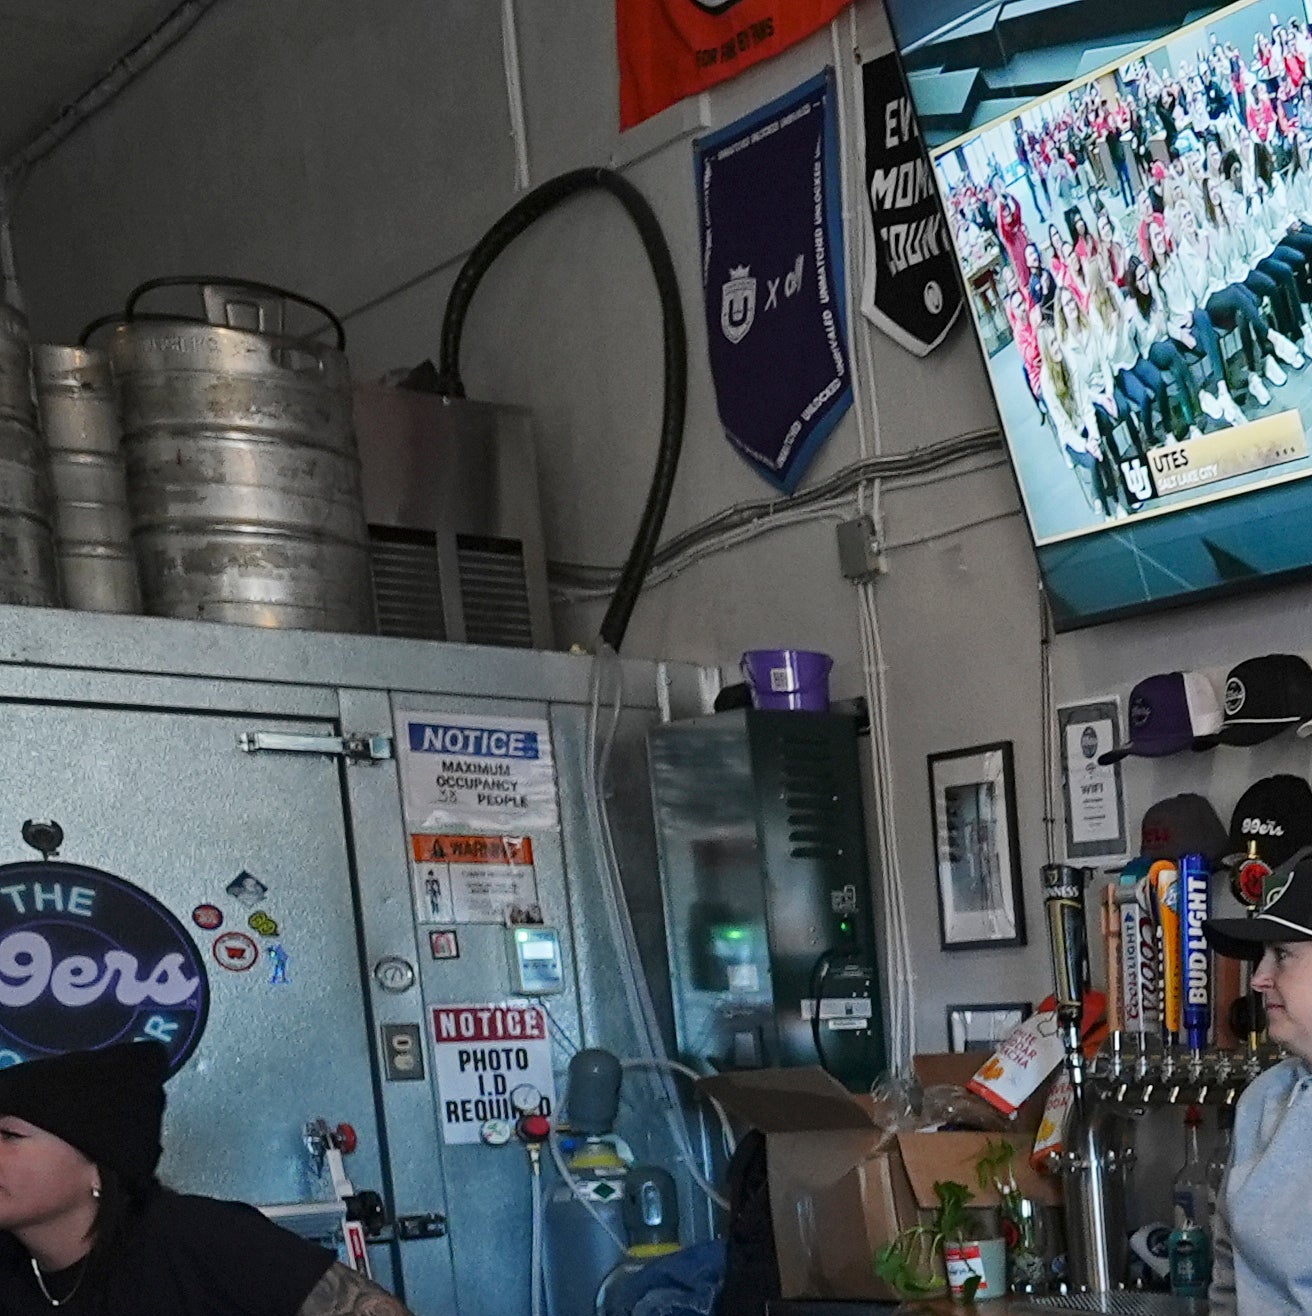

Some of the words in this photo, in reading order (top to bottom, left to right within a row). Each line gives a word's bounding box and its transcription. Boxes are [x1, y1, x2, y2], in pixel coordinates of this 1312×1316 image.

[1152, 448, 1189, 474] UTES
[422, 726, 526, 757] NOTICE
[441, 760, 511, 777] MAXIMUM
[436, 775, 518, 791] OCCUPANCY
[477, 793, 528, 808] PEOPLE
[1241, 817, 1285, 838] 99ers
[1, 881, 96, 918] THE
[1187, 876, 1208, 949] LIGHT
[1126, 924, 1137, 970] LIGHT
[1187, 952, 1208, 1005] BUD
[438, 1010, 540, 1038] NOTICE
[458, 1048, 529, 1072] PHOTO
[478, 1074, 507, 1096] I.D
[445, 1096, 552, 1123] REQUID
